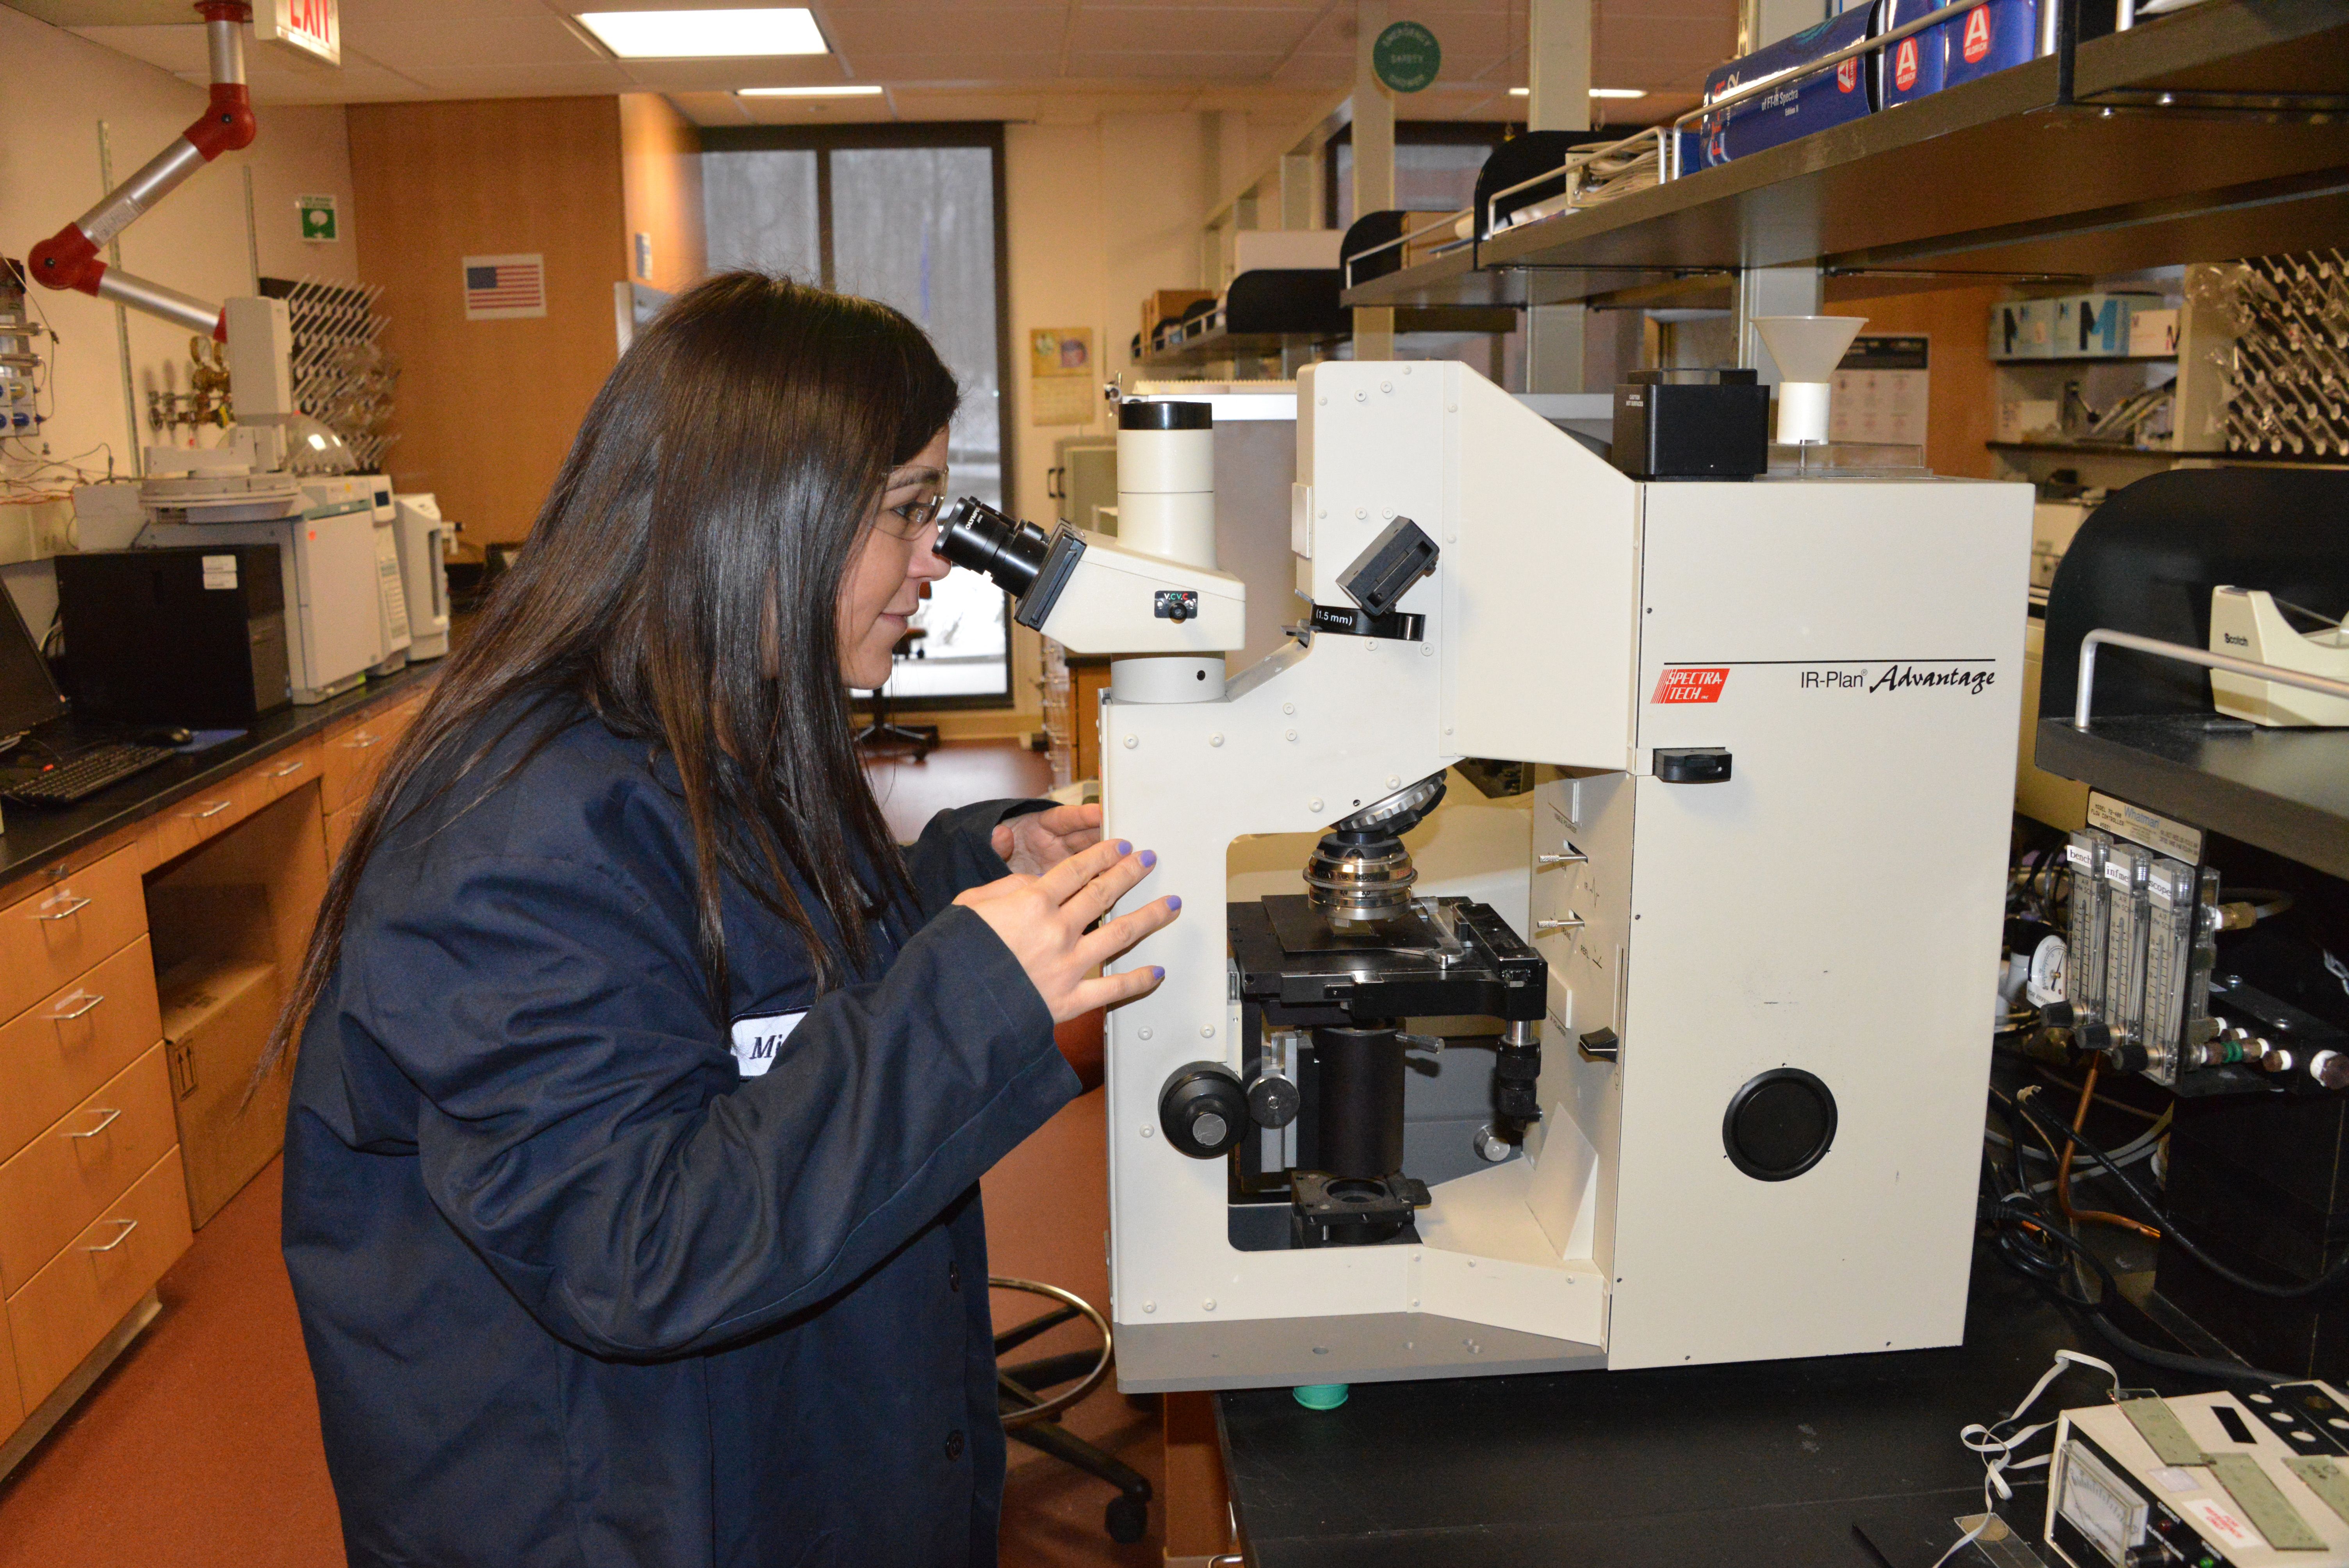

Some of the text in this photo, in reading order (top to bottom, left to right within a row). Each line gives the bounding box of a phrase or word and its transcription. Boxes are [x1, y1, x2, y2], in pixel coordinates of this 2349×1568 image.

[1965, 41, 1988, 57] ALDRICH
[1897, 71, 1915, 85] ALDRICH
[1761, 98, 1767, 111] of
[1780, 89, 1798, 106] Spectra
[1316, 609, 1353, 626] (1.5 mm)
[2224, 633, 2248, 647] Scotch
[1869, 665, 1995, 695] Advantage
[1670, 687, 1702, 700] TECH
[2095, 804, 2106, 813] MODEL
[2101, 813, 2124, 826] CONTROLLER
[2069, 849, 2092, 865] bench
